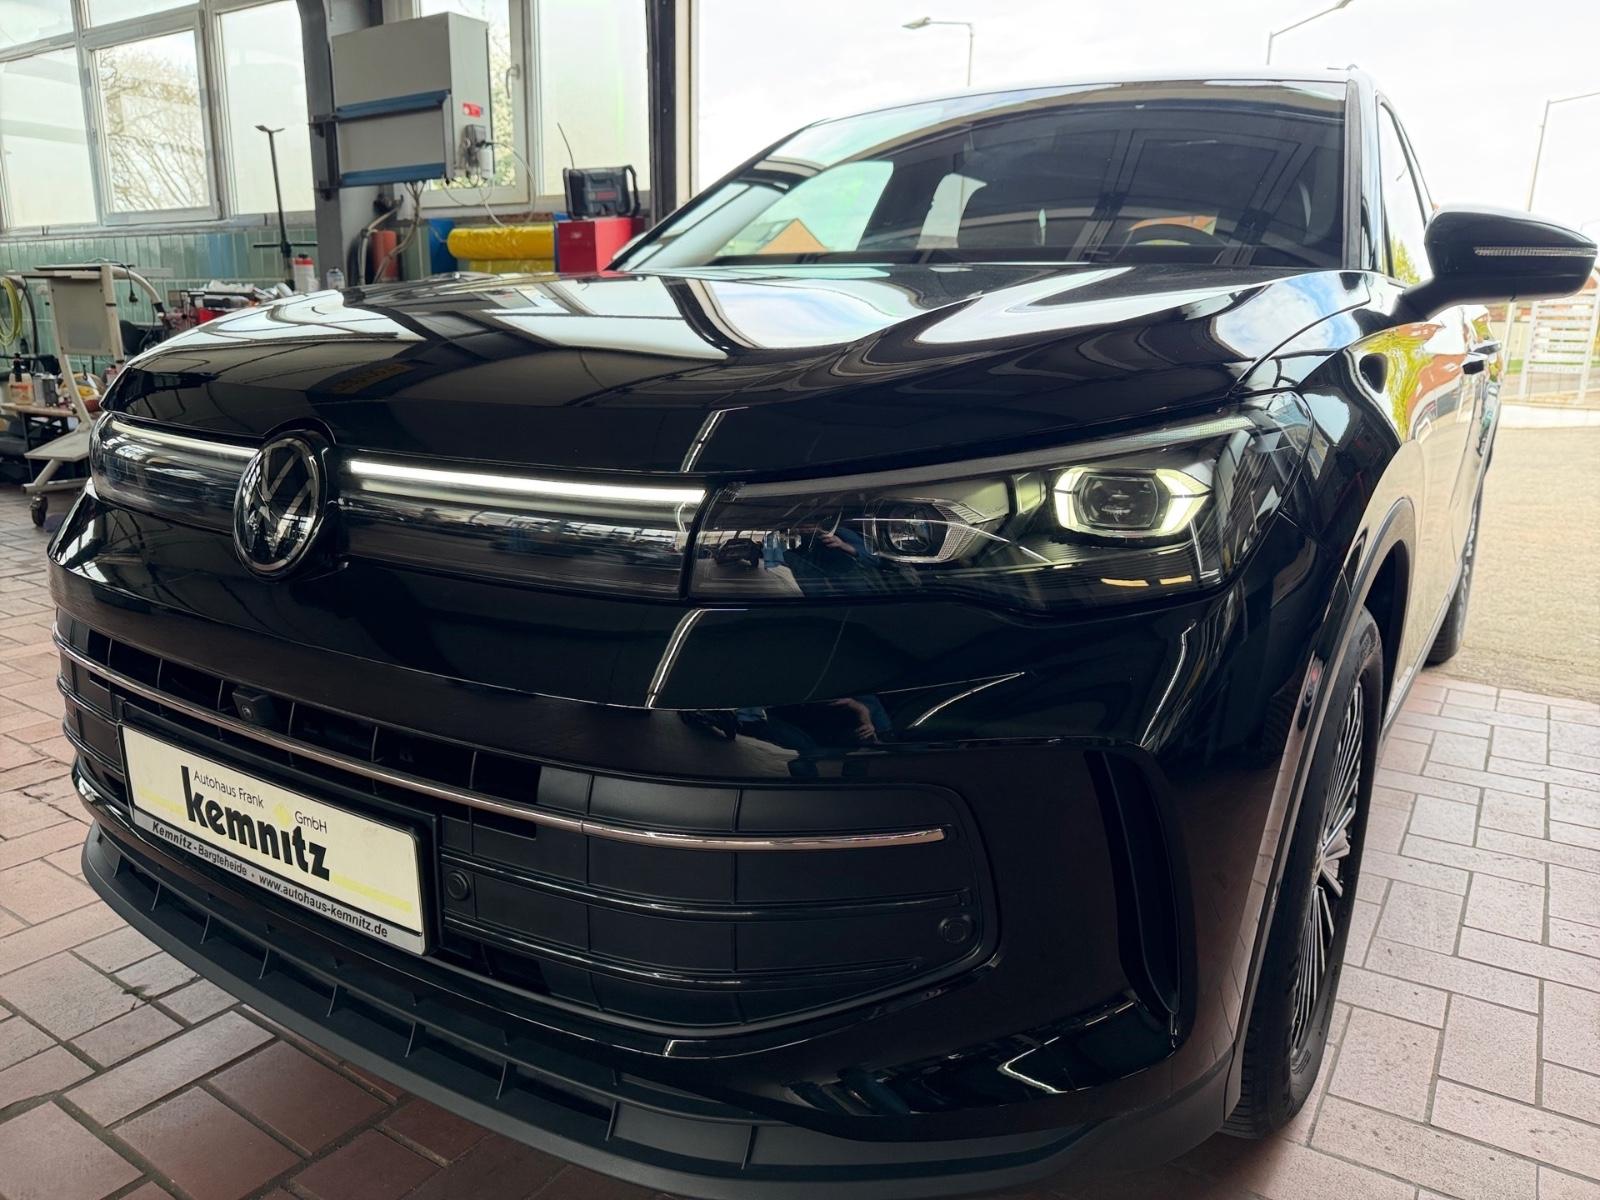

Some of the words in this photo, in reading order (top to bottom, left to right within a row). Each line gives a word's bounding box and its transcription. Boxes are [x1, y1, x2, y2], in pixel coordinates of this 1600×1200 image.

[180, 765, 330, 881] kemnitz
[194, 770, 236, 798] Autohaus
[238, 787, 264, 808] Frank
[294, 810, 327, 833] GmbH
[152, 821, 192, 850] Kemnitz
[198, 843, 247, 876] Bargteheide
[258, 874, 388, 938] www.autohaus-kemnitz.de
